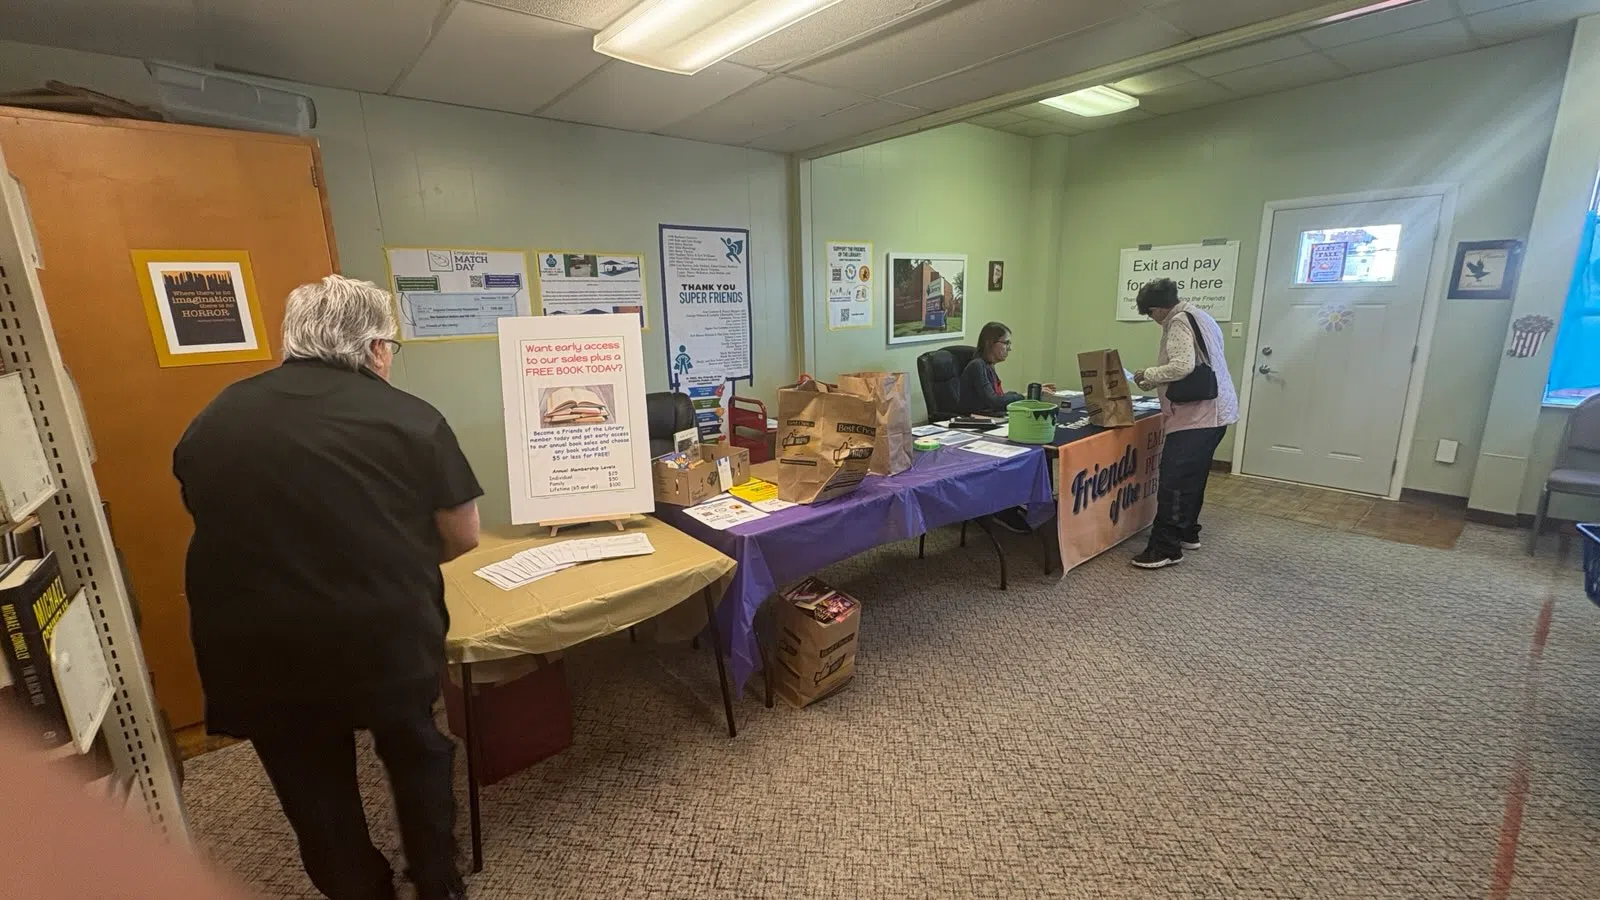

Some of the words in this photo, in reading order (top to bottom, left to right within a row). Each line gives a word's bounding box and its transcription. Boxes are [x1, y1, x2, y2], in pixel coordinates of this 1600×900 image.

[1133, 259, 1158, 272] Exit
[1162, 258, 1189, 270] and
[1193, 258, 1221, 272] pay
[1126, 280, 1145, 291] for
[1190, 277, 1223, 289] here
[172, 296, 235, 304] imagination
[680, 292, 707, 304] SUPER
[709, 292, 743, 303] FRIENDS
[525, 344, 552, 352] Want
[555, 343, 581, 353] early
[584, 341, 620, 350] access
[561, 354, 588, 362] sales
[590, 353, 612, 363] plus
[525, 367, 554, 376] FREE
[556, 365, 584, 375] BOOK
[585, 364, 622, 374] TODAY?
[839, 424, 855, 432] Best
[1071, 443, 1137, 516] Friends
[1109, 488, 1120, 526] of
[1122, 481, 1140, 511] the
[32, 576, 66, 630] MICHAEL
[1, 604, 21, 632] MICHAEL
[10, 632, 30, 660] CONNELLY
